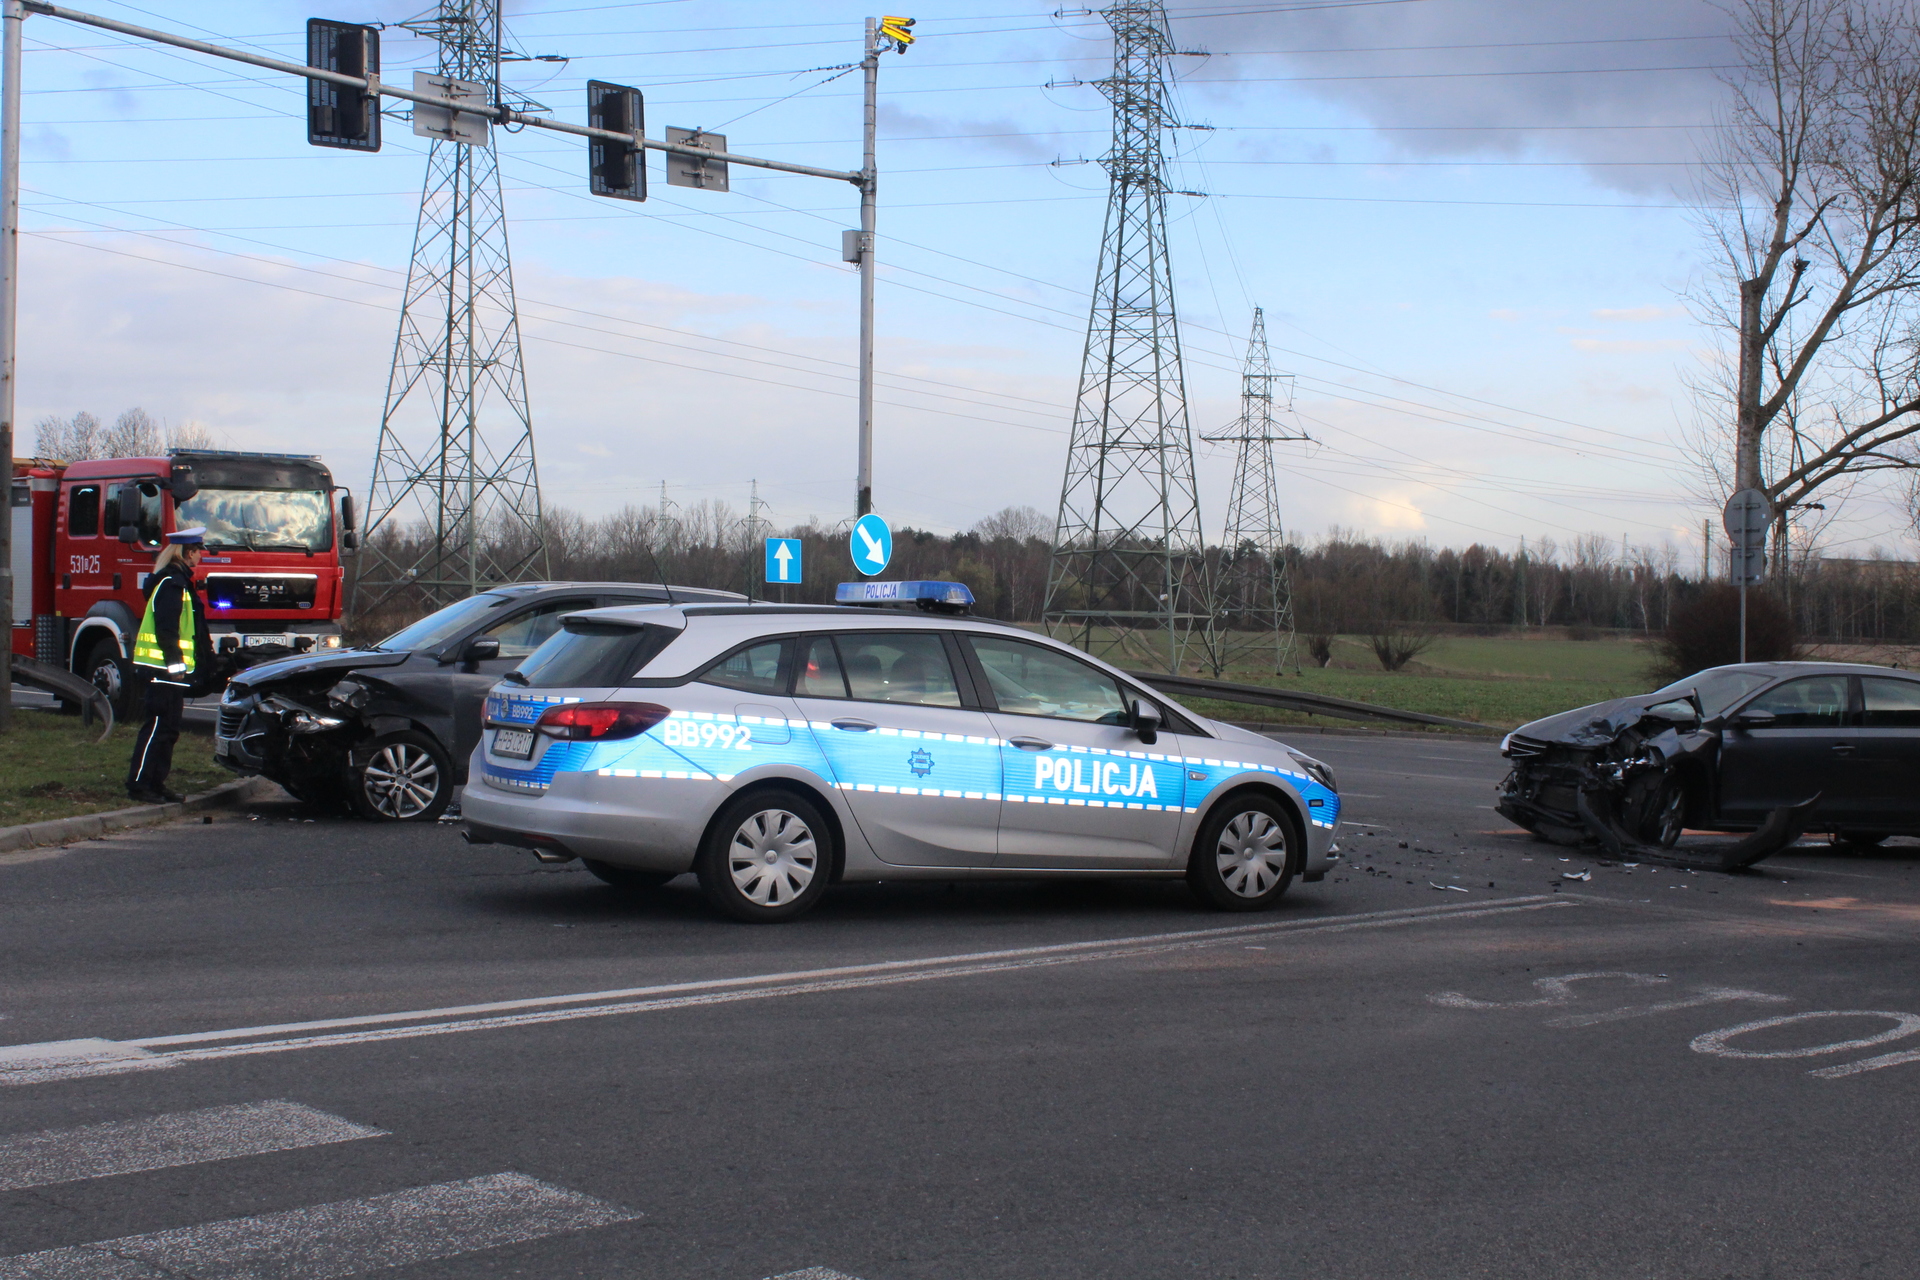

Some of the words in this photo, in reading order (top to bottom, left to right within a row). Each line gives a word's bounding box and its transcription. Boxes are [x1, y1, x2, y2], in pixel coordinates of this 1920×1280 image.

[244, 585, 284, 595] MAN
[865, 583, 898, 599] POLICJA
[512, 704, 534, 720] BB992
[663, 719, 753, 751] BB992
[1034, 755, 1158, 799] POLICJA
[1425, 971, 1920, 1080] STO
